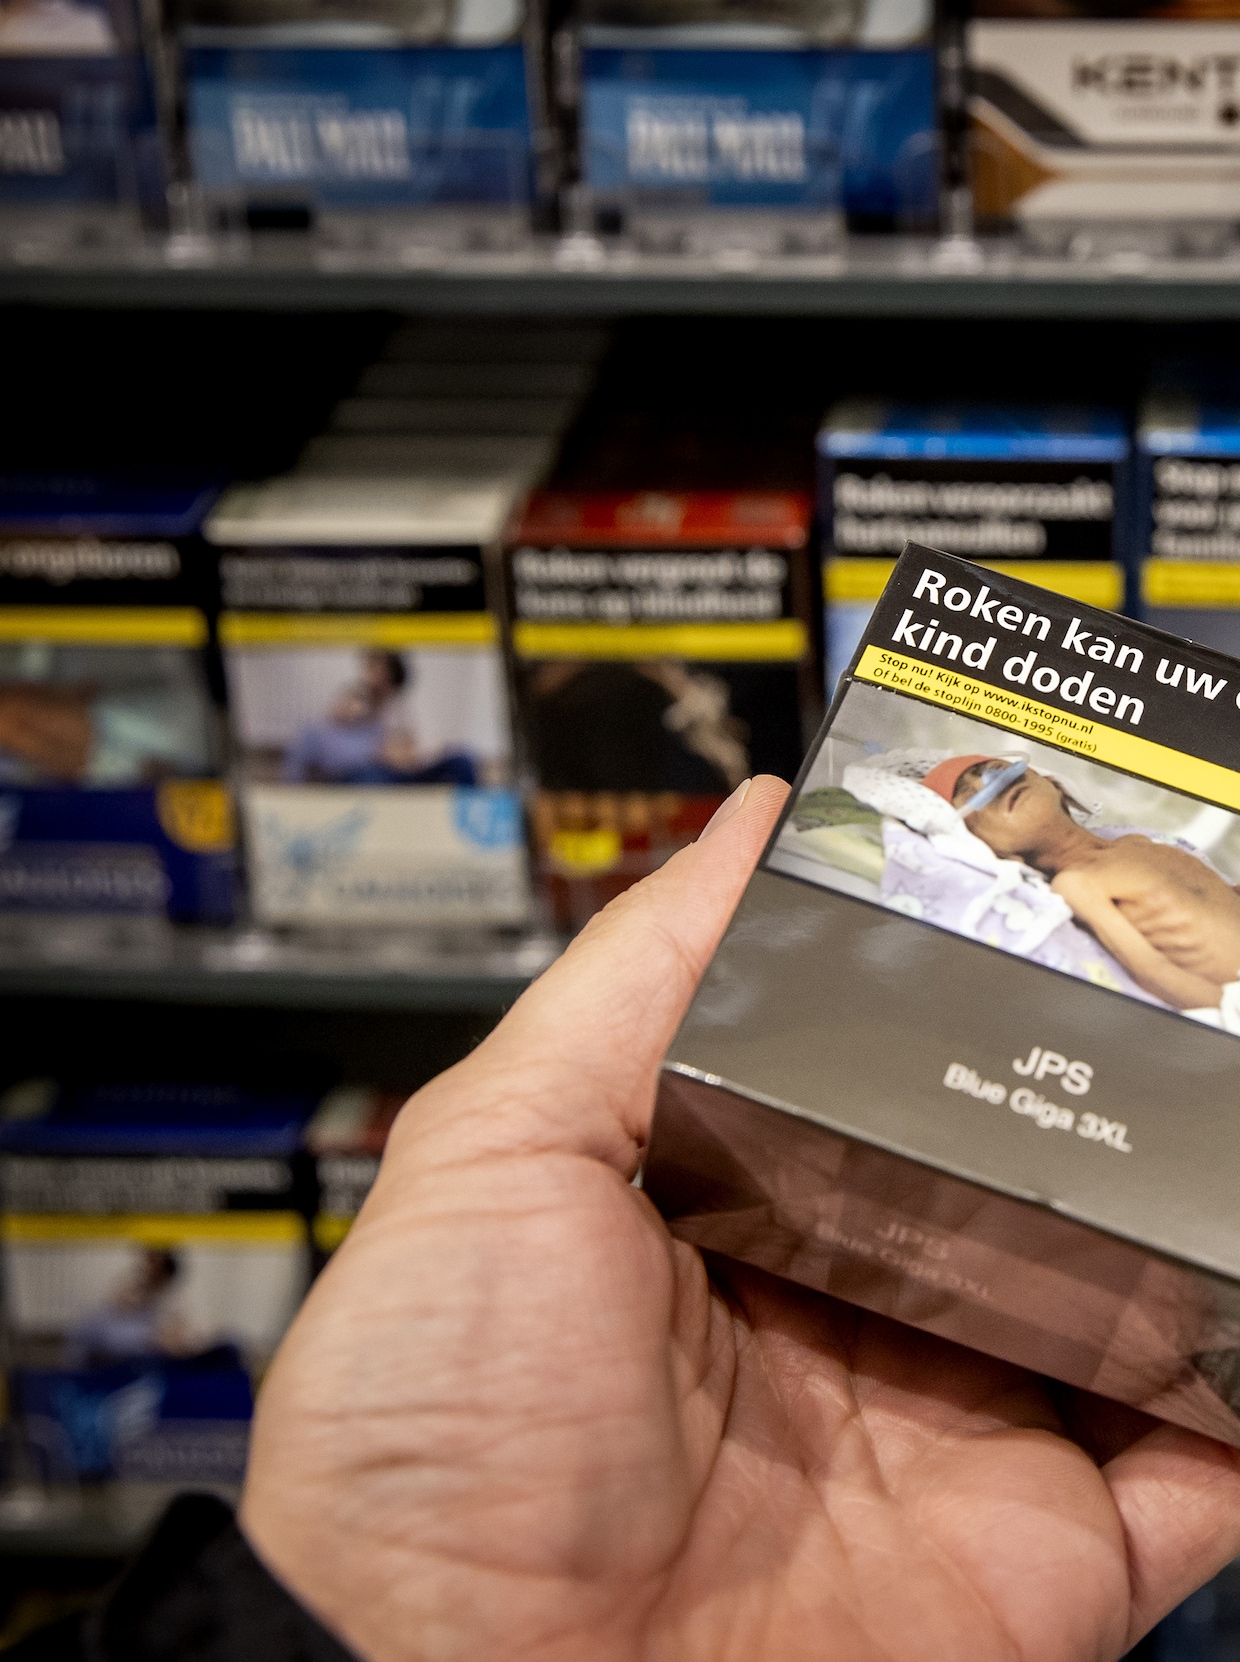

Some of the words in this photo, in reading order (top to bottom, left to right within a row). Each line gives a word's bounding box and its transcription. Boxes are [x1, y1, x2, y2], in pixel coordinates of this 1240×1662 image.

[891, 608, 997, 671] kind
[1002, 650, 1145, 726] doden
[912, 567, 1051, 641] Roken
[1061, 617, 1145, 674] kan
[1155, 657, 1229, 701] uw
[873, 667, 890, 680] Of
[892, 672, 913, 687] bel
[914, 679, 931, 694] de
[933, 688, 983, 712] stoplijn
[984, 704, 1054, 737] 0800-1995
[1056, 731, 1098, 754] (gratis)
[879, 653, 909, 670] Stop
[911, 663, 934, 679] nu!
[936, 671, 962, 688] Kijk
[963, 682, 980, 696] op
[983, 689, 1095, 735] www.ikstopnu.nl
[943, 1061, 1007, 1105] Blue
[1009, 1087, 1075, 1132] Giga
[1076, 1111, 1133, 1154] 3XL
[1012, 1046, 1094, 1096] JPS
